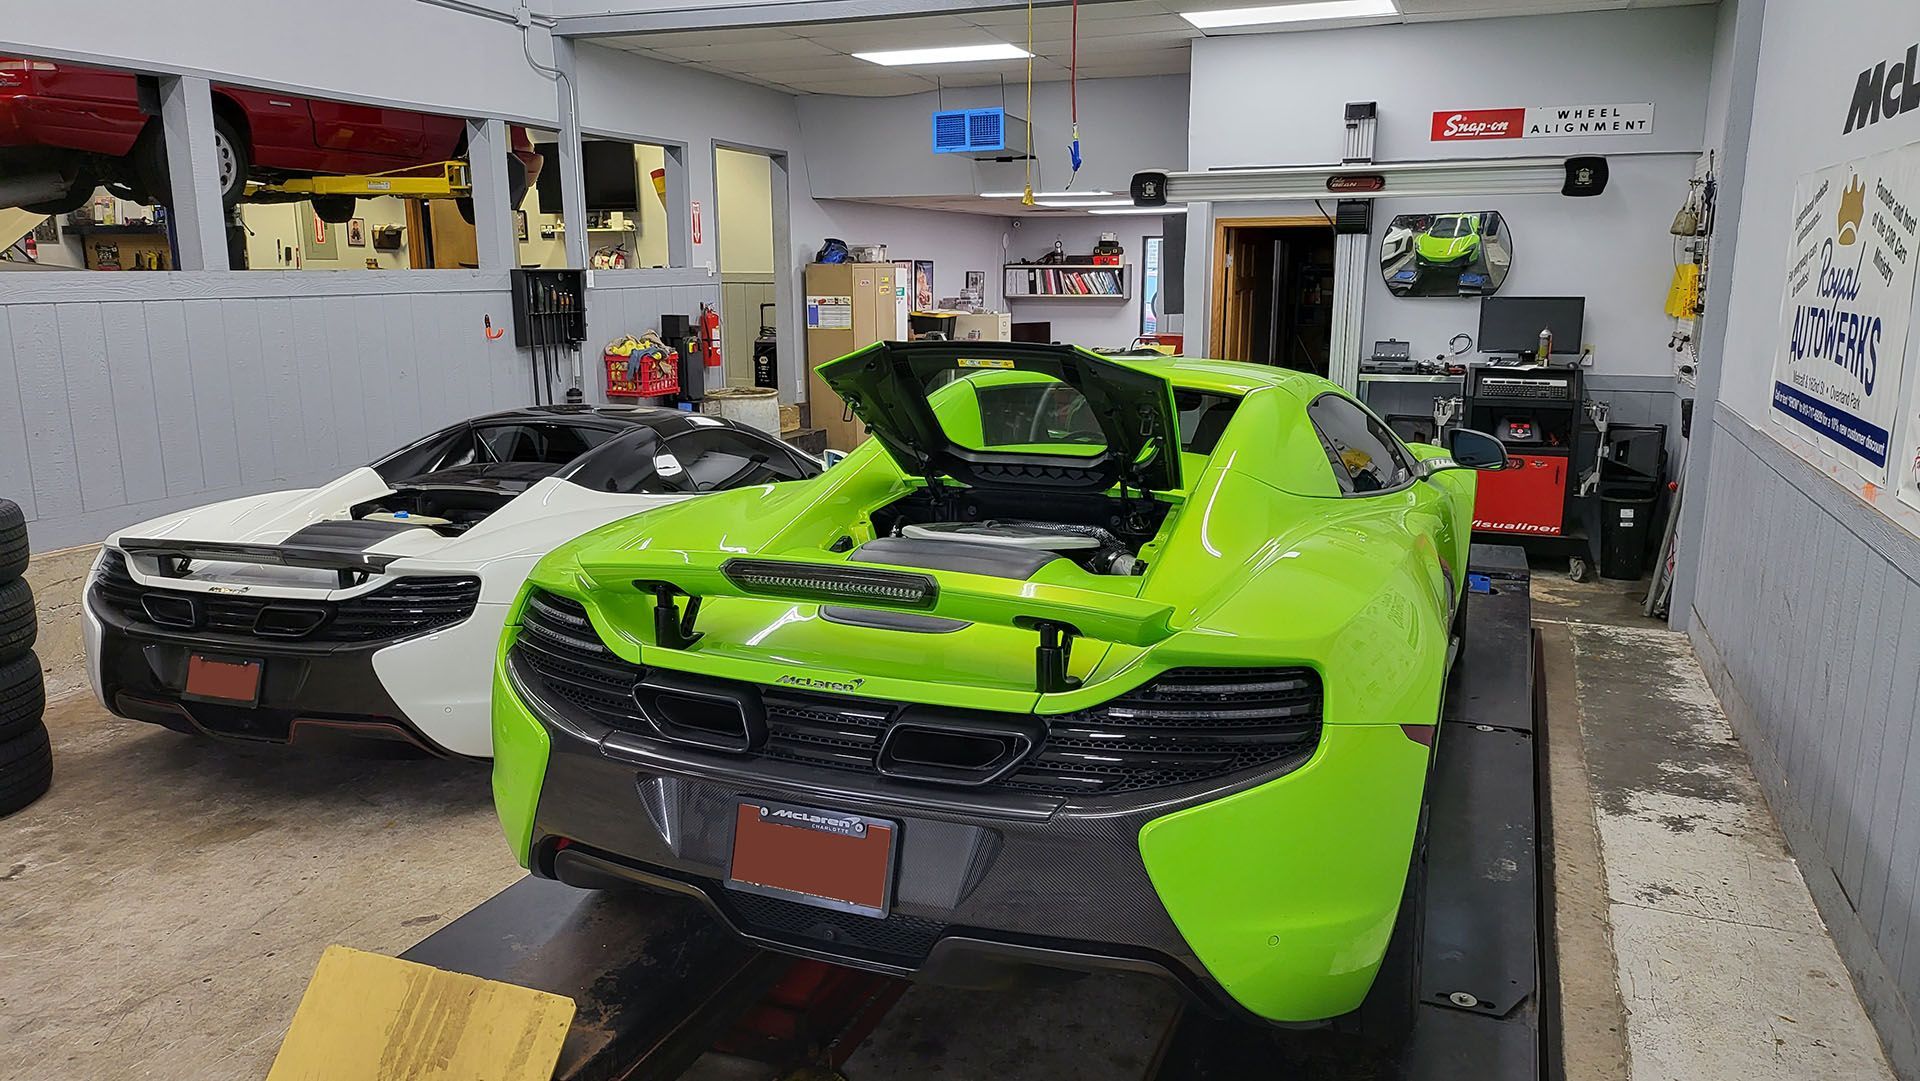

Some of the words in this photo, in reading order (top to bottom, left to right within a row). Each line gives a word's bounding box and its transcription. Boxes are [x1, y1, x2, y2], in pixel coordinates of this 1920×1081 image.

[1443, 114, 1510, 137] Snap-on
[1530, 120, 1647, 134] ALIGNMENT
[1557, 108, 1621, 120] WHEEL
[1875, 177, 1895, 212] Founder
[1892, 201, 1905, 224] and
[1902, 207, 1918, 237] host
[1872, 211, 1880, 229] of
[1876, 215, 1886, 238] the
[1894, 237, 1908, 265] Cars
[1816, 237, 1866, 322] Royal
[1872, 246, 1894, 288] Ministry
[1788, 305, 1882, 397] AUTOWERKS
[1830, 384, 1851, 407] Overland
[1850, 392, 1860, 411] Park
[1846, 428, 1866, 446] customer
[1865, 434, 1885, 456] discount
[775, 674, 855, 692] McLaren
[771, 809, 851, 828] McLaren
[811, 823, 849, 834] CHARLOTTE
